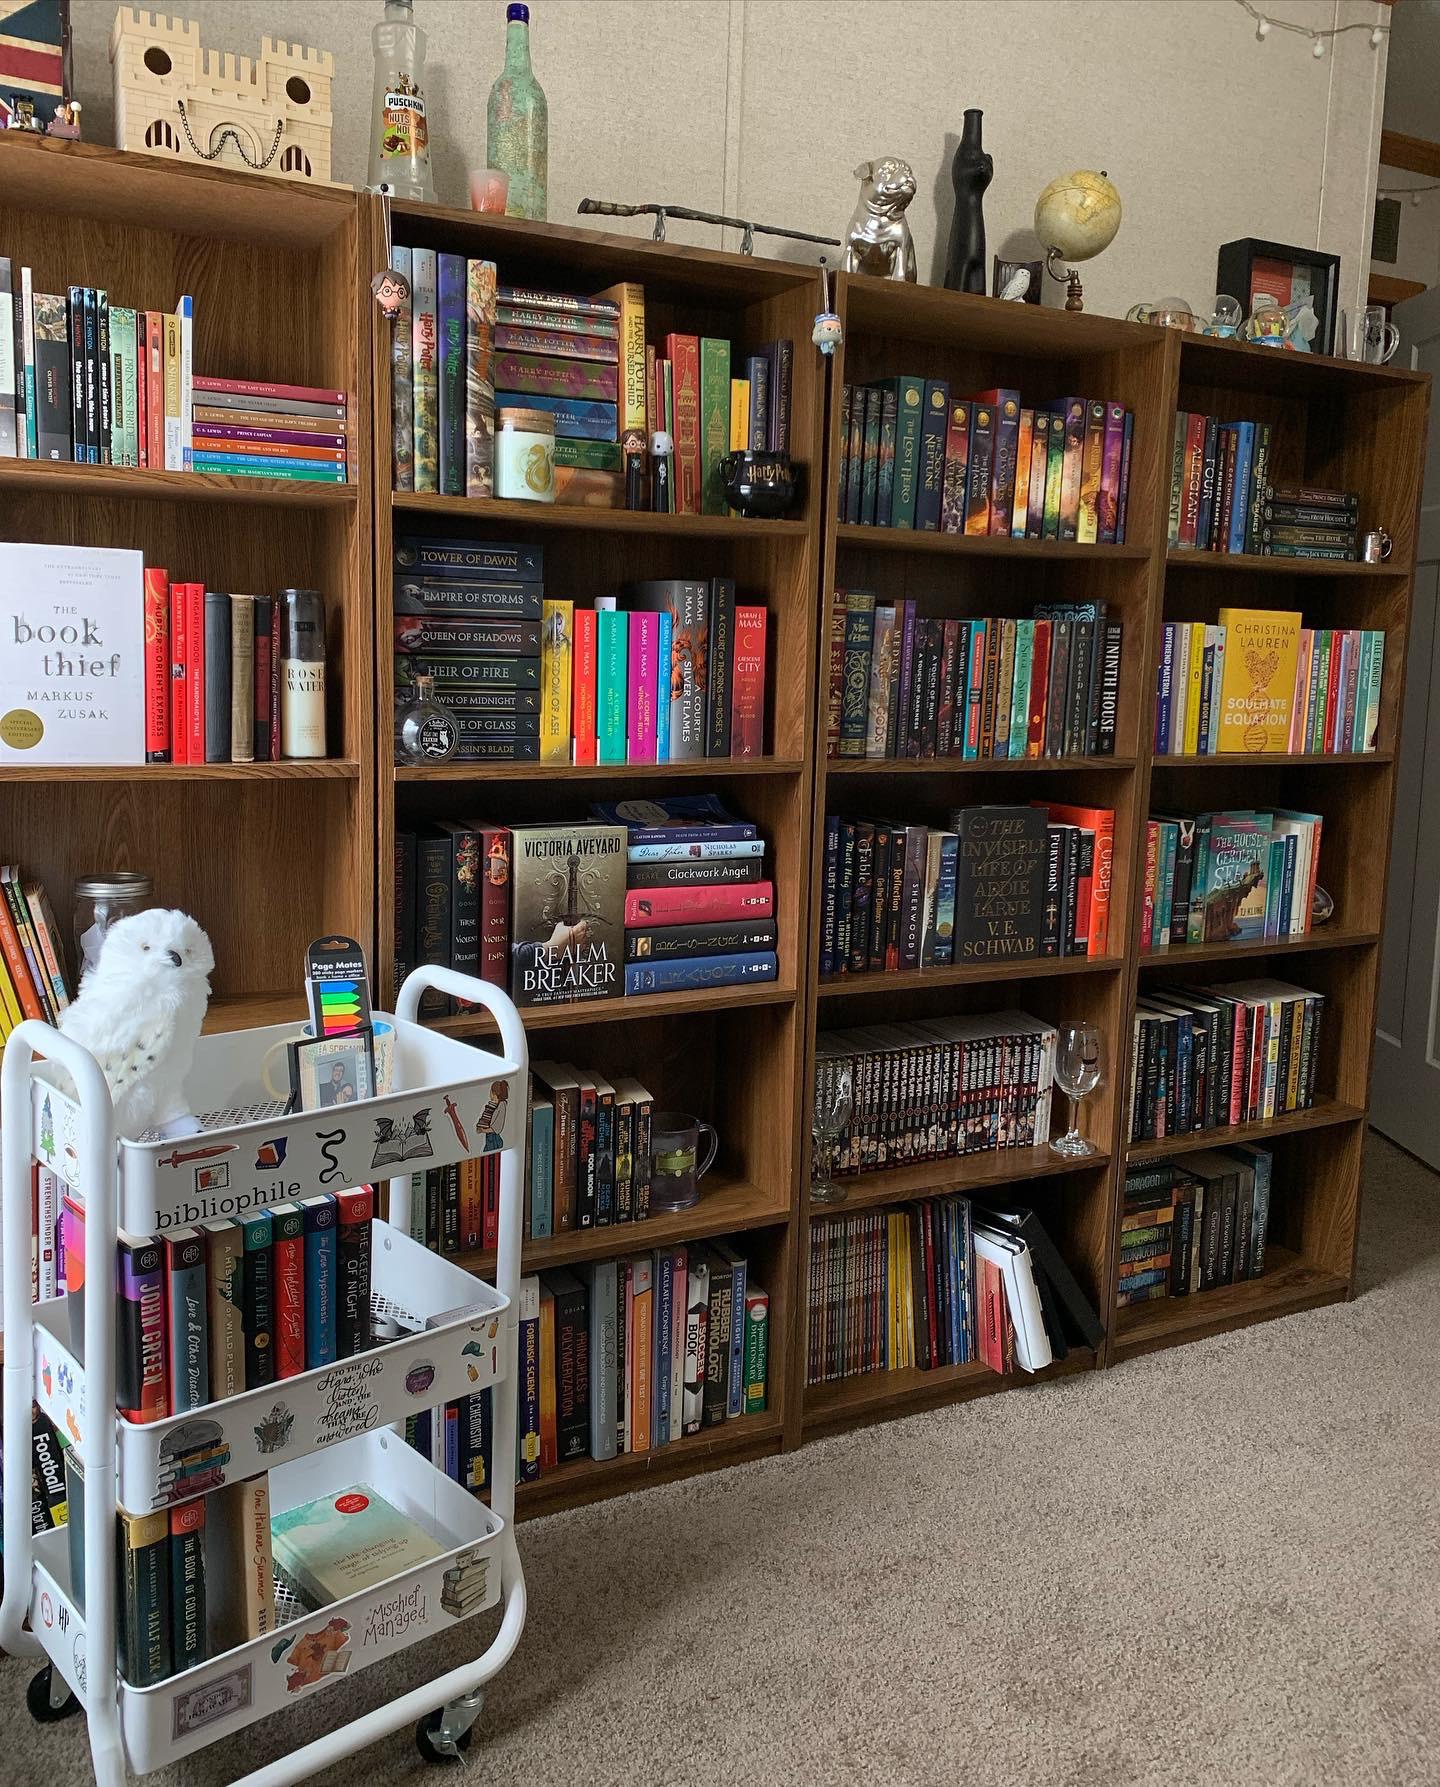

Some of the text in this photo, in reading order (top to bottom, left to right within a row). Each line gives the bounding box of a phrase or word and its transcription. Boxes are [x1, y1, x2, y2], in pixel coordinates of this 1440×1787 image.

[388, 97, 423, 112] PUSCHKIN
[389, 113, 410, 124] NUTS
[75, 361, 83, 375] the
[634, 315, 645, 410] HARRY POTTER
[125, 358, 135, 442] PRINCESS BRIDE
[900, 436, 914, 504] LOST HERO
[924, 433, 935, 489] NEPTUNE
[980, 469, 989, 499] HOUSE
[1169, 440, 1184, 523] INSURGENT
[1187, 443, 1202, 528] ALLEGIANT
[1202, 458, 1215, 500] FOUR
[421, 551, 463, 563] TOWER
[484, 555, 518, 566] DAWN
[53, 605, 78, 615] THE
[424, 591, 463, 602] EMPIRE
[481, 593, 524, 604] STORMS
[684, 595, 692, 625] MAAS
[696, 588, 704, 621] SARAH
[12, 613, 103, 647] book
[421, 631, 456, 642] QUEEN
[473, 632, 522, 643] SHADOWS
[739, 619, 763, 629] MAAS
[1235, 624, 1296, 636] CHRISTINA
[1240, 637, 1290, 649] LAUREN
[41, 651, 121, 678] thief
[155, 602, 165, 737] MURDER ORIENT EXPRESS
[287, 668, 324, 680] ROSE
[427, 666, 459, 678] HEIR
[482, 667, 510, 678] FIRE
[737, 662, 761, 673] CITY
[1161, 626, 1174, 698] BOYFRIEND MATERIAL
[1371, 655, 1380, 687] KENNEDY
[287, 681, 325, 692] WATER
[695, 684, 701, 693] A
[715, 623, 726, 733] COURT THORNS ROSES
[1100, 641, 1120, 733] NINTH HOUSE
[27, 690, 93, 702] MARKUS
[469, 696, 516, 705] MIDNIGHT
[682, 661, 692, 742] SILVER FLAMES
[1227, 697, 1287, 710] SOULMATE
[57, 708, 109, 720] ZUSAK
[484, 720, 516, 730] GLASS
[1224, 713, 1287, 726] EQUATION
[487, 745, 515, 754] BLADE
[524, 837, 621, 858] VICTORIA AVEYARD
[638, 845, 684, 861] Dear John
[704, 843, 737, 851] NICHOLAS
[845, 841, 854, 866] Matt
[1233, 833, 1263, 848] HOUSE
[721, 865, 750, 877] Angel
[858, 848, 872, 884] Fable
[1047, 834, 1060, 892] FURYBORN
[1094, 837, 1113, 902] CURSED
[1213, 866, 1243, 892] SEA
[825, 866, 836, 953] LOST APOTHECARY
[908, 883, 919, 949] SHERWOOD
[837, 920, 845, 950] LIBRARY
[988, 920, 1018, 936] V. E.
[534, 941, 608, 971] REALM
[963, 936, 1035, 957] SCHWAB
[311, 961, 363, 970] Page Mates
[523, 962, 616, 992] BREAKER
[1220, 1050, 1230, 1104] INQUISITION
[587, 1153, 595, 1173] FOOL
[44, 1177, 52, 1246] STRENGTHSFINDER
[155, 1180, 302, 1231] bibliophile
[357, 1247, 369, 1298] KEEPER
[318, 1268, 330, 1325] Hypothesis
[346, 1279, 359, 1320] NIGHT
[187, 1320, 201, 1332] &
[224, 1255, 235, 1397] HISTORY WILD PLACES
[719, 1288, 731, 1344] RUBBER
[139, 1283, 163, 1387] JOHN GREEN
[187, 1332, 201, 1358] Other
[687, 1323, 698, 1357] BOOK
[706, 1289, 722, 1385] TECHNOLOGY
[526, 1323, 535, 1402] FORENSIC SCIENCE
[695, 1326, 707, 1375] SOCCER
[747, 1324, 758, 1383] DICTIONARY
[469, 1403, 482, 1449] CHEMISTRY
[33, 1432, 66, 1494] Football
[252, 1489, 267, 1601] One Italian Summer
[184, 1556, 196, 1651] BOOK COLD CASES
[370, 1584, 422, 1625] Mischief
[363, 1595, 428, 1646] Managed
